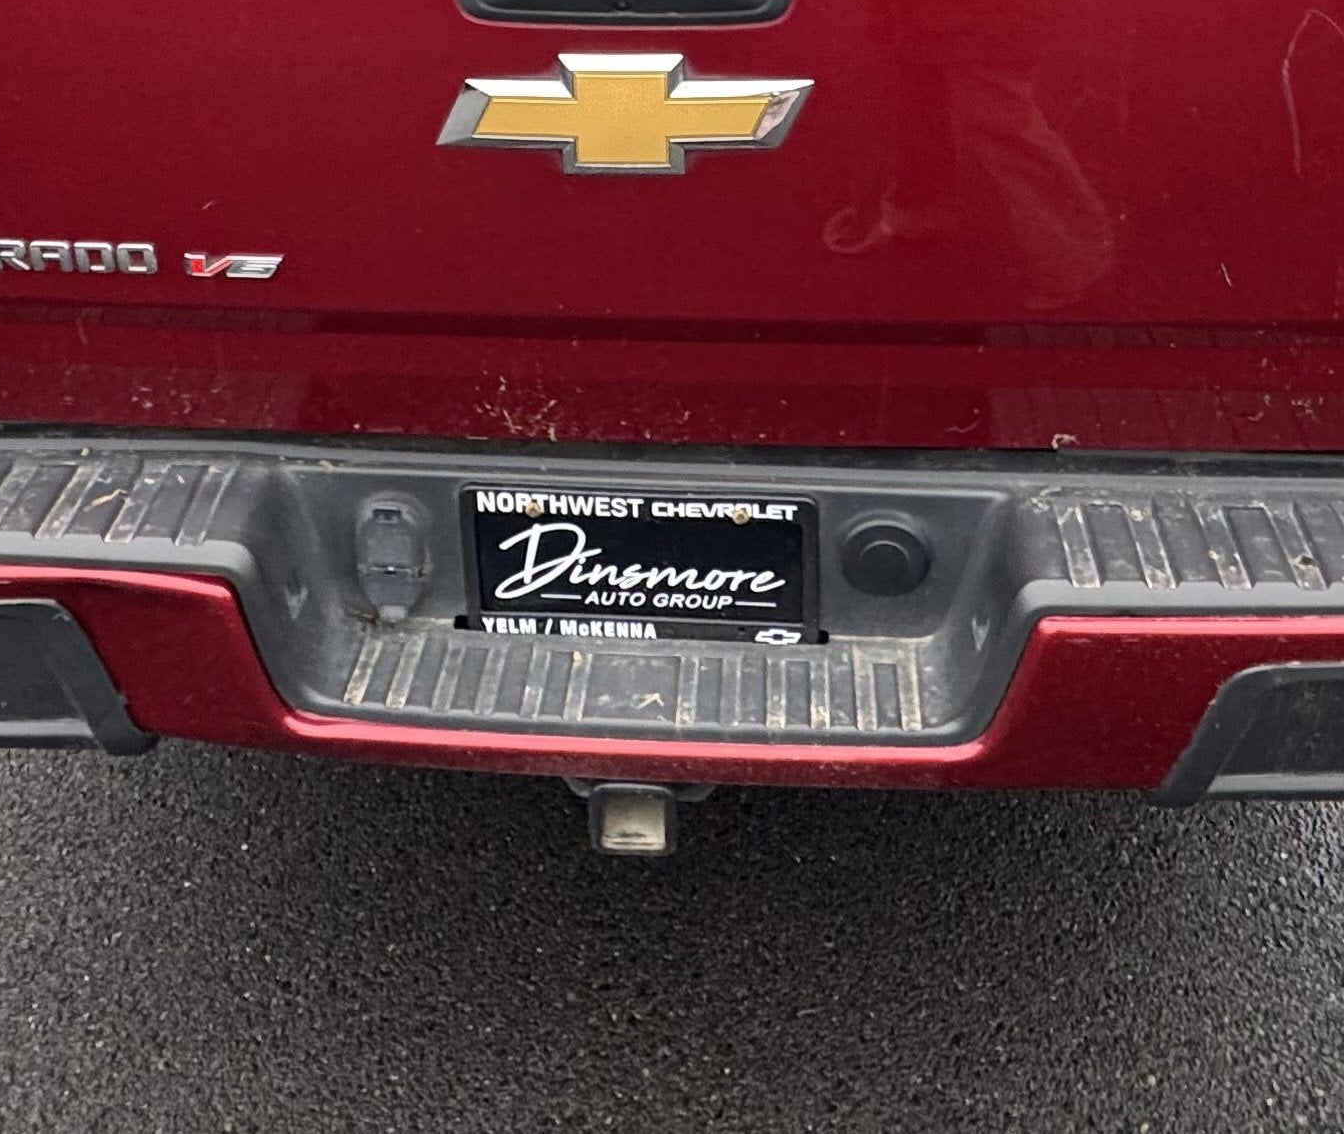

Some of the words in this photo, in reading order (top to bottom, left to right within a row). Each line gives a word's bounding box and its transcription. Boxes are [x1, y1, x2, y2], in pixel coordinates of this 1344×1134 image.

[183, 252, 285, 279] V6
[476, 490, 644, 518] NORTHWEST
[651, 502, 799, 521] CHEVROLET
[494, 522, 787, 600] Dinsmore
[584, 591, 647, 608] AUTO
[652, 593, 734, 611] GROUP
[481, 616, 538, 635] YELM
[559, 618, 657, 640] McKENNA
